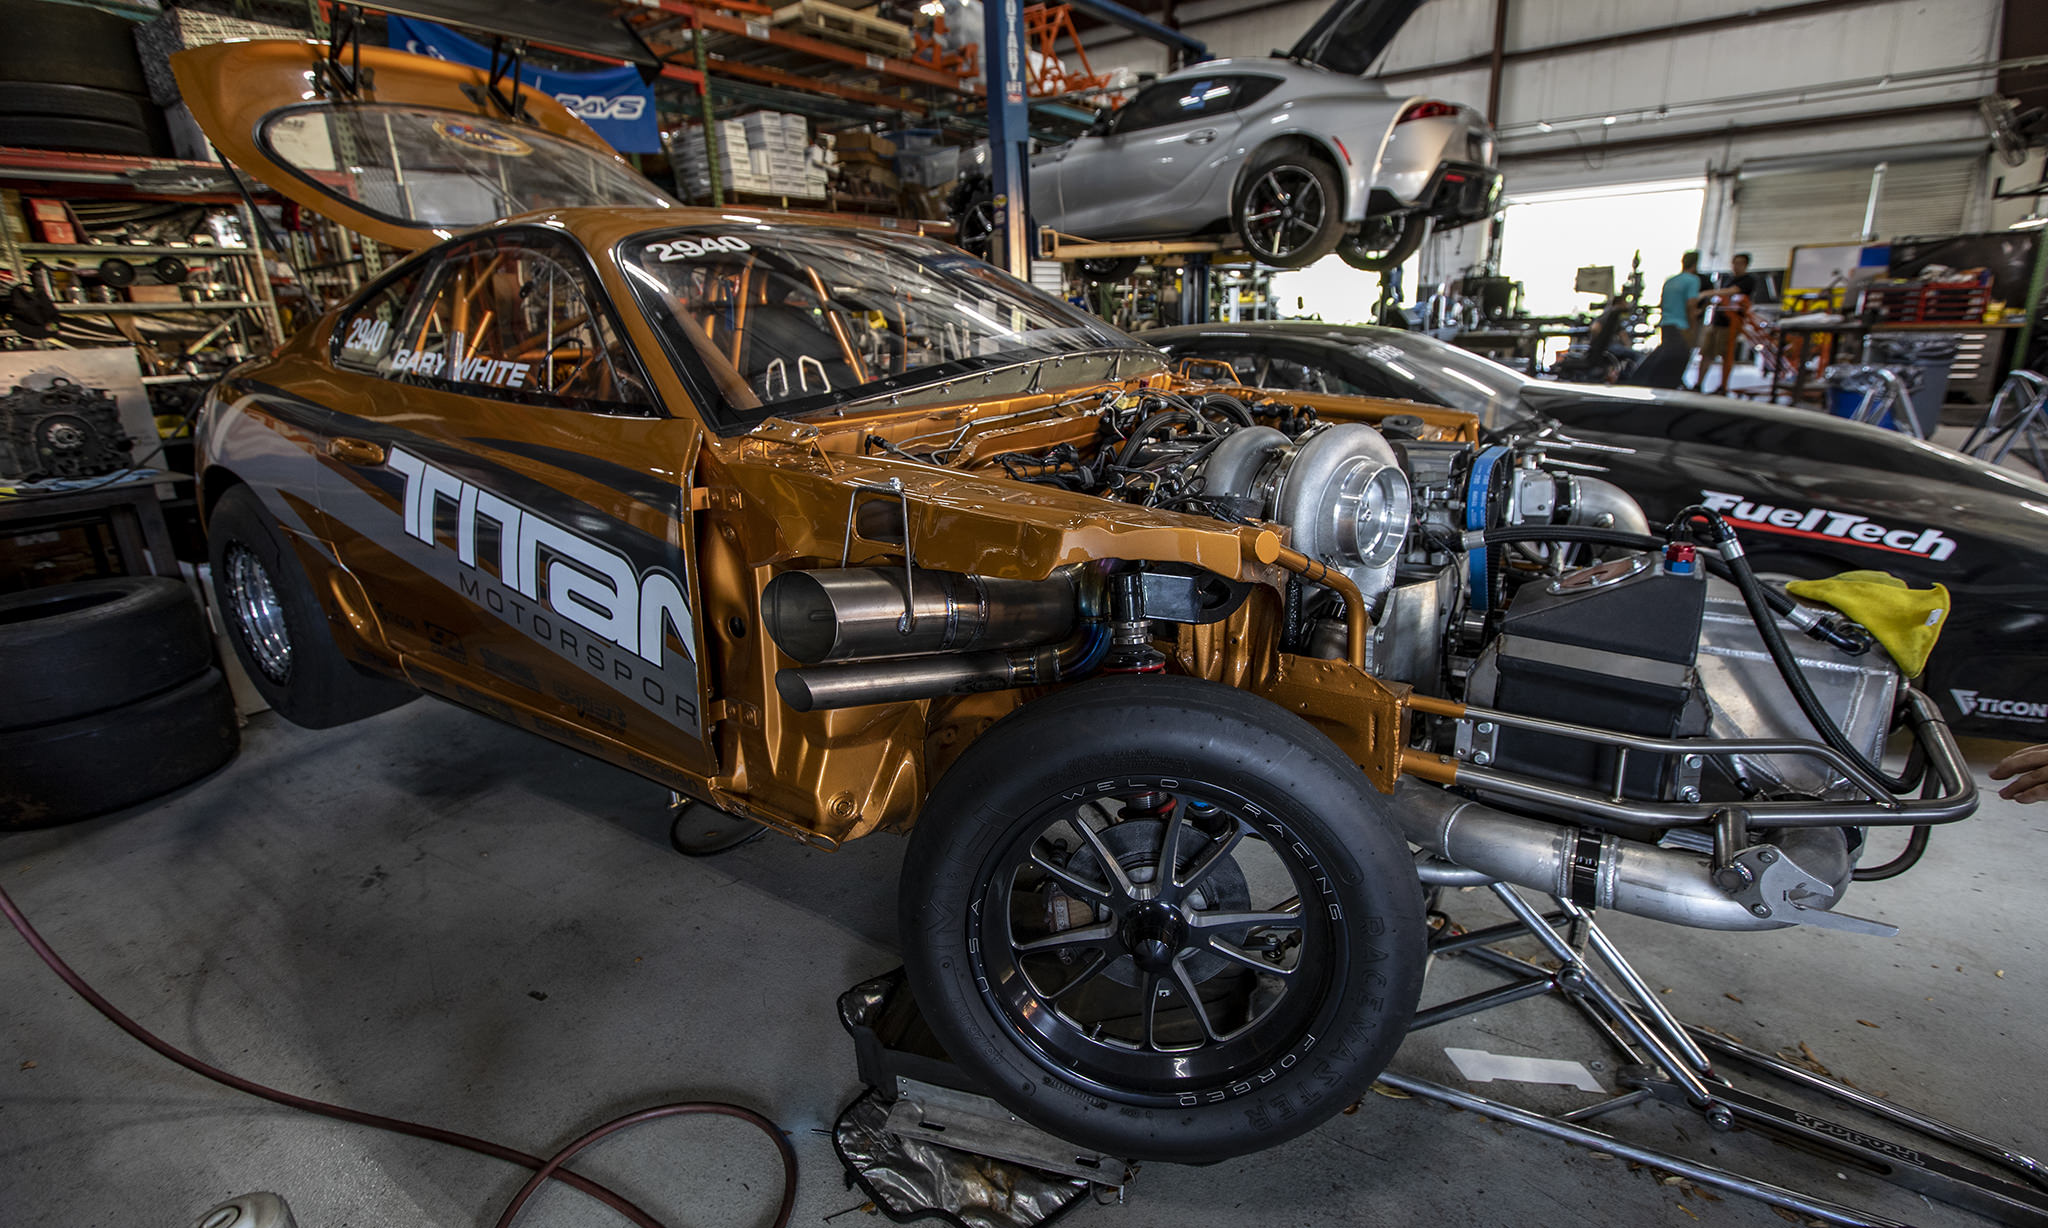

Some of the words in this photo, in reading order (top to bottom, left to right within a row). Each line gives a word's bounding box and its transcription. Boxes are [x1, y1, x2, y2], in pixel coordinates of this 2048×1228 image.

[554, 93, 646, 120] RAYS
[645, 236, 752, 262] 2940
[344, 317, 389, 352] 2940
[391, 349, 447, 376] GARY
[453, 354, 531, 389] WHITE
[1700, 489, 1958, 562] FuelTech
[458, 571, 698, 728] MOTORSPOR
[1062, 778, 1180, 801] WELD
[1241, 802, 1343, 922] RACING
[1244, 914, 1390, 1133] RACEMASTER
[1179, 1032, 1317, 1108] FORGED
